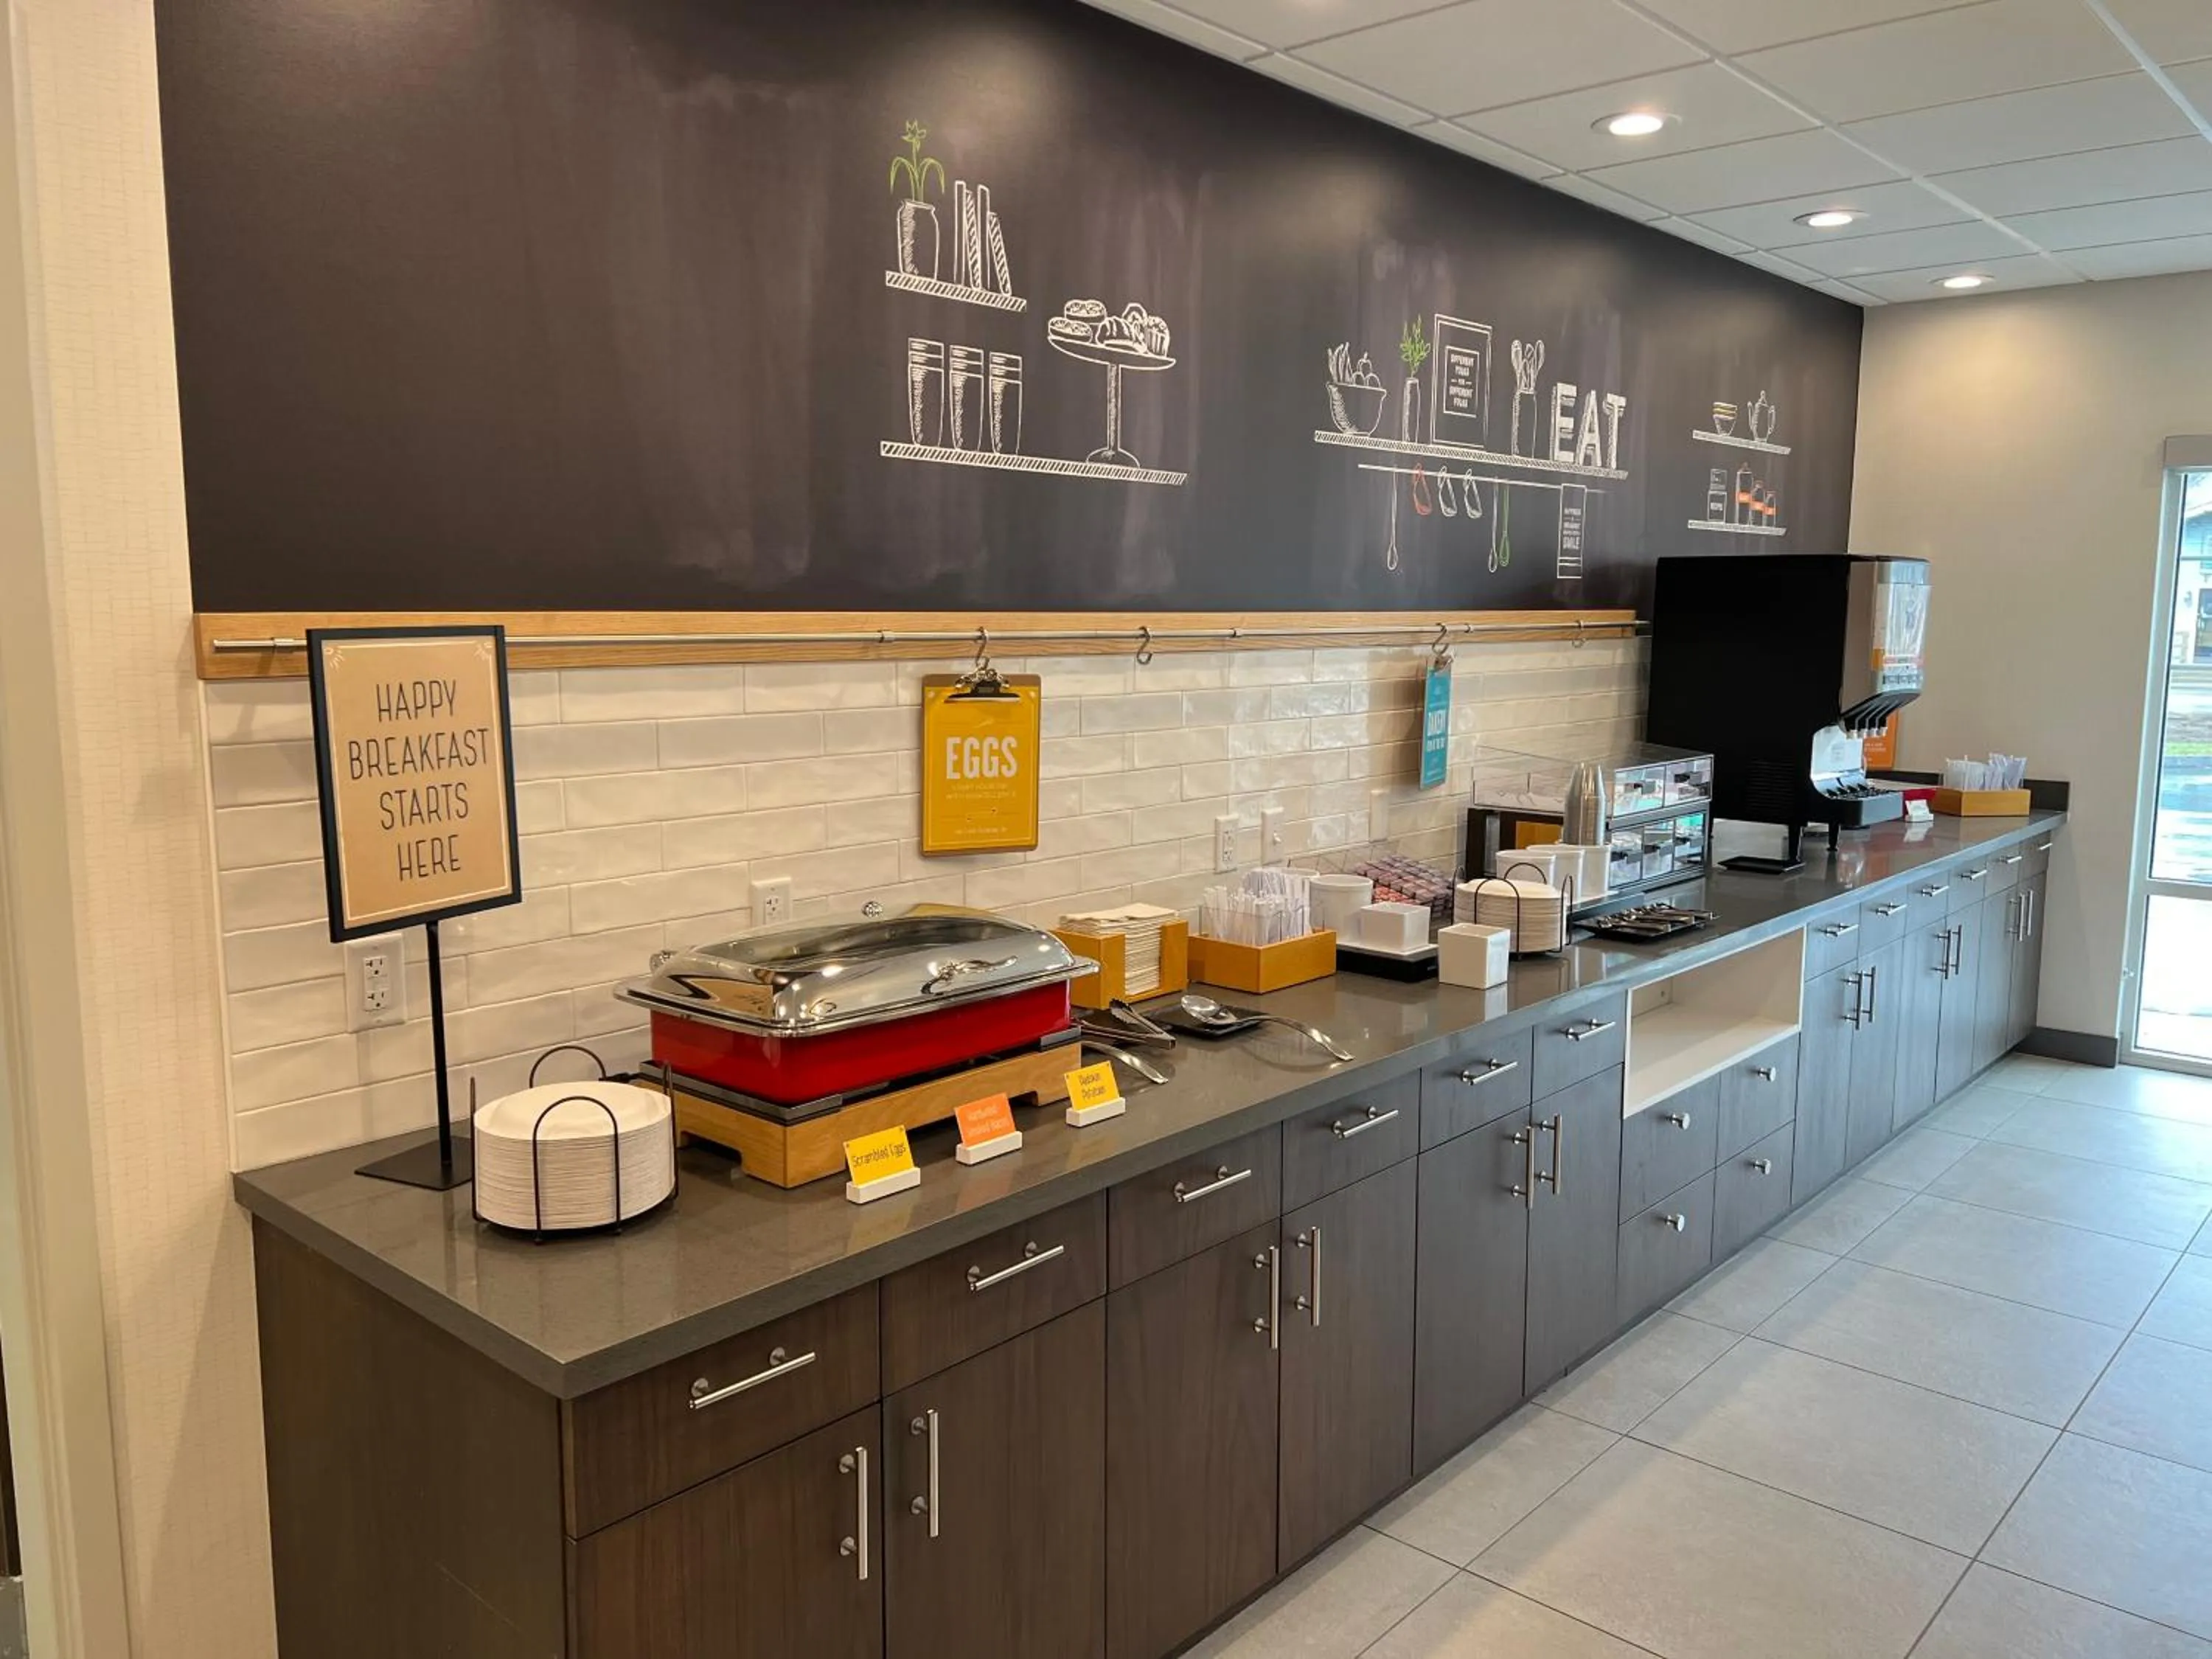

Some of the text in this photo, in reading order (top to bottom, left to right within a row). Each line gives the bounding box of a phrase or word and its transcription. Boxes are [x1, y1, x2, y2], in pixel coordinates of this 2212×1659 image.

[1551, 382, 1627, 470] EAT
[375, 679, 457, 723] HAPPY
[348, 727, 490, 781] BREAKFAST
[945, 736, 1018, 779] EGGS
[379, 782, 469, 831] STARTS
[397, 833, 462, 882] HERE
[851, 1144, 889, 1168] Scrambled
